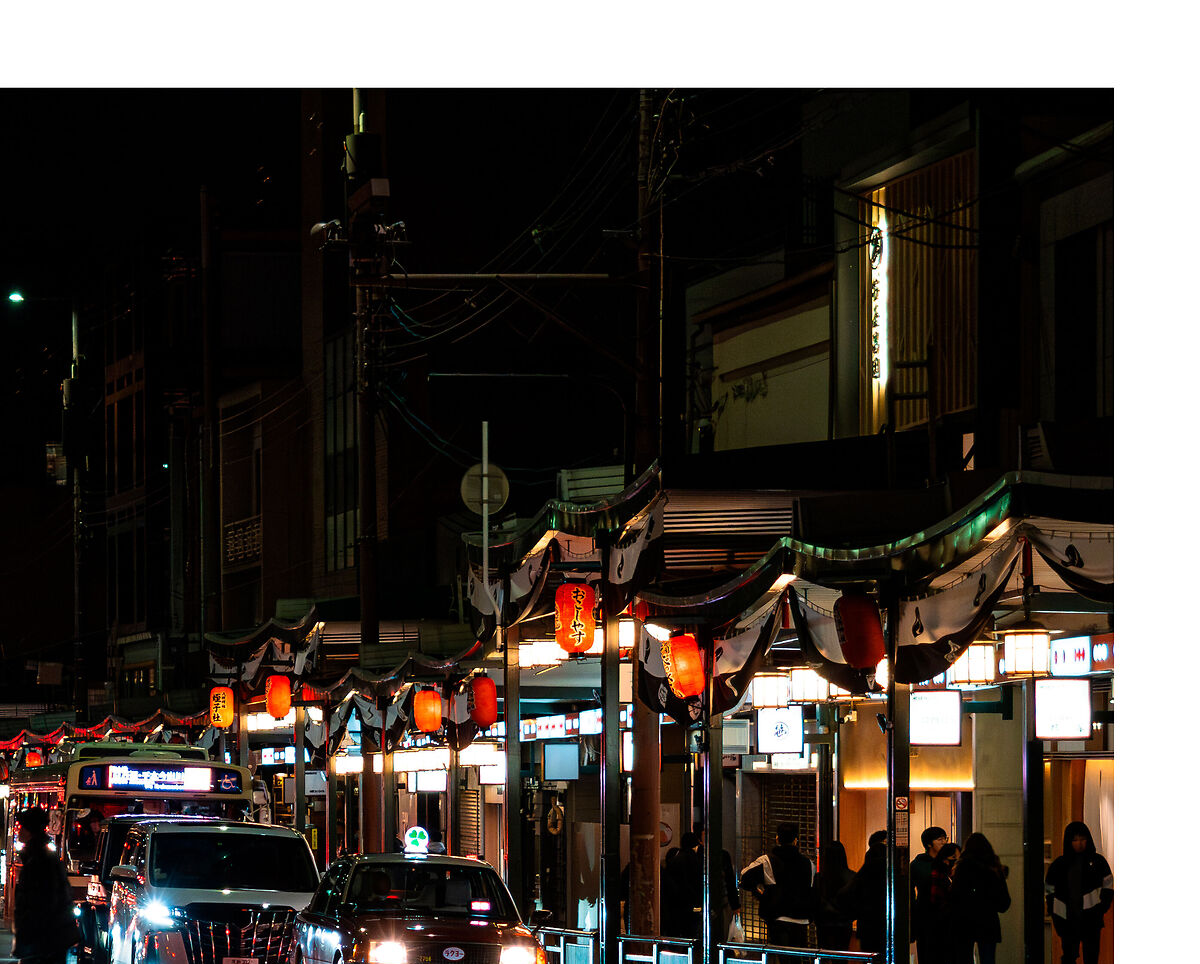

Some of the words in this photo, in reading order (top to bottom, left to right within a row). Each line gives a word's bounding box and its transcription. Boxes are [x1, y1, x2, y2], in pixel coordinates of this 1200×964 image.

[570, 587, 586, 646] おこしやす
